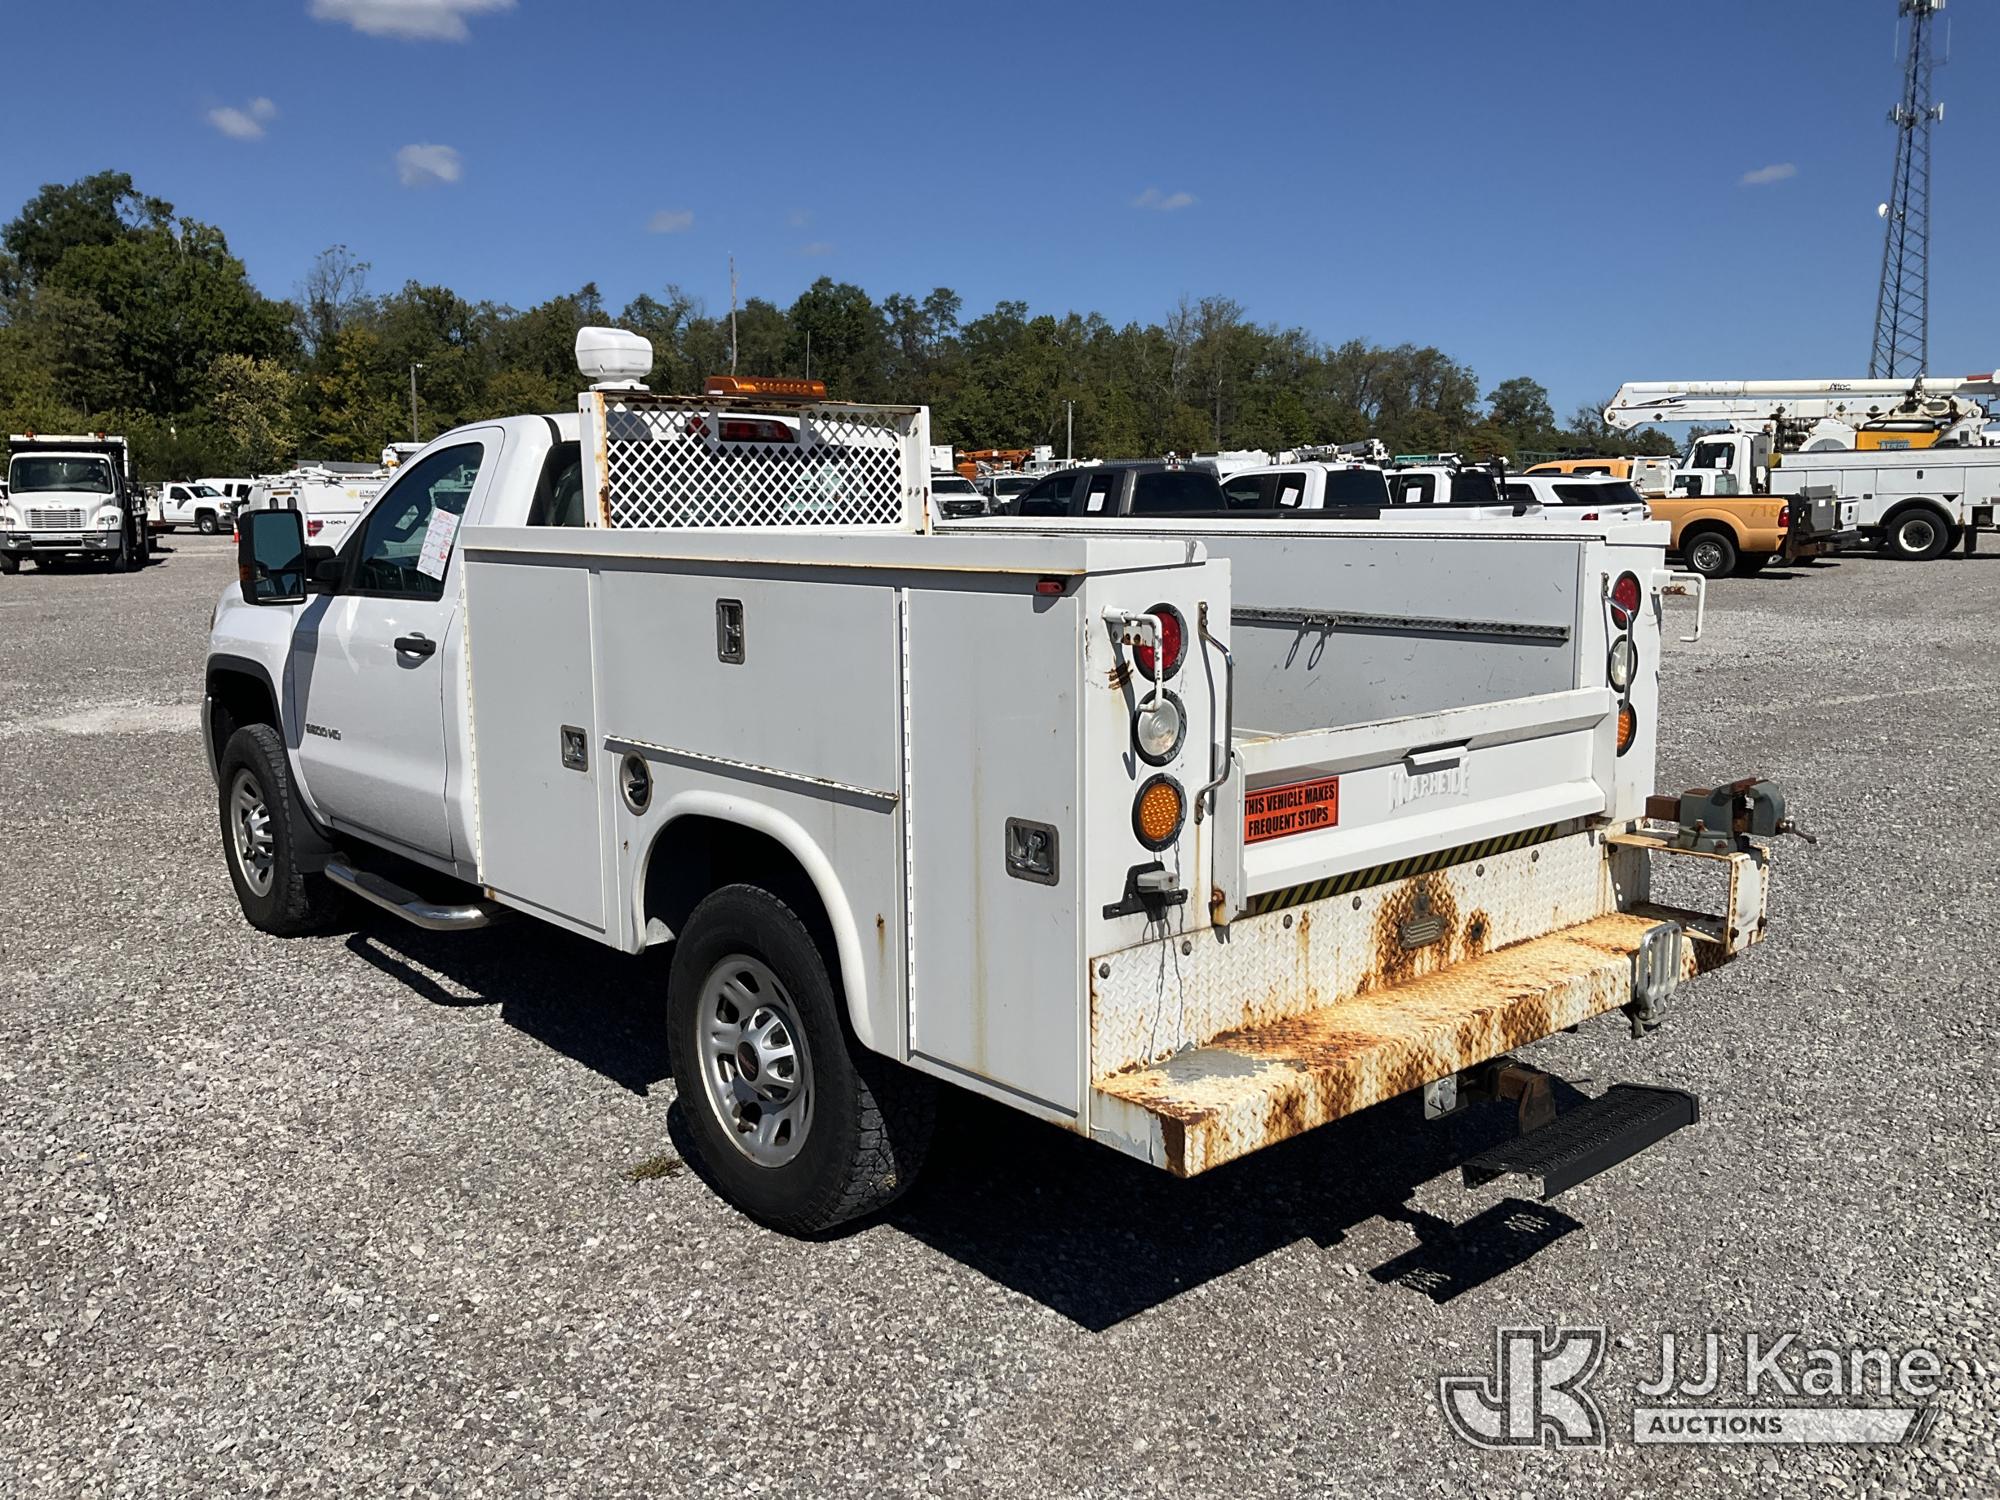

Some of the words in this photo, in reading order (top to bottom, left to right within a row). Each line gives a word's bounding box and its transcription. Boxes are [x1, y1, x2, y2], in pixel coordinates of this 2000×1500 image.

[1244, 796, 1265, 817] THIS
[1265, 790, 1303, 812] VEHICLE
[1304, 784, 1335, 805] MAKES
[1248, 812, 1297, 837] FREQUENT
[1297, 806, 1329, 827] STOPS
